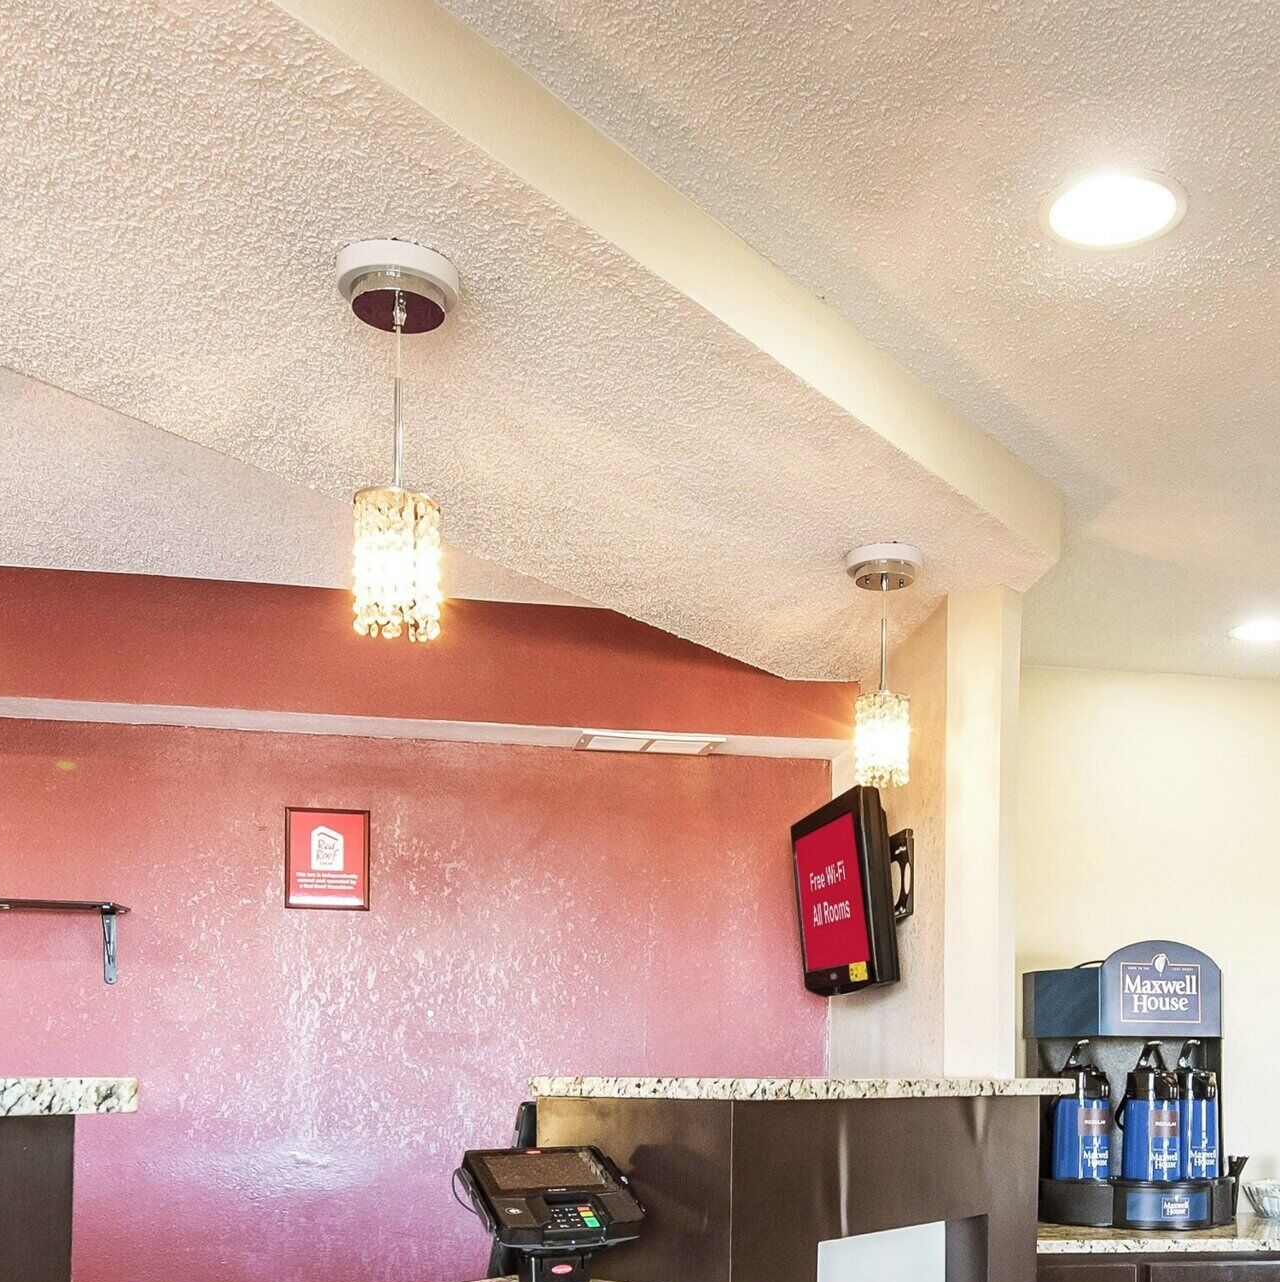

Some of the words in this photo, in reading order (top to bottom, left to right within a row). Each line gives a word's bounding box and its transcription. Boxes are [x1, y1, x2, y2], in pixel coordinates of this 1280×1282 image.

[809, 872, 826, 892] Free
[825, 860, 847, 886] Wi-Fi
[813, 903, 824, 928] All
[823, 900, 851, 925] Rooms
[1123, 974, 1198, 995] Maxwell
[1132, 994, 1190, 1014] House
